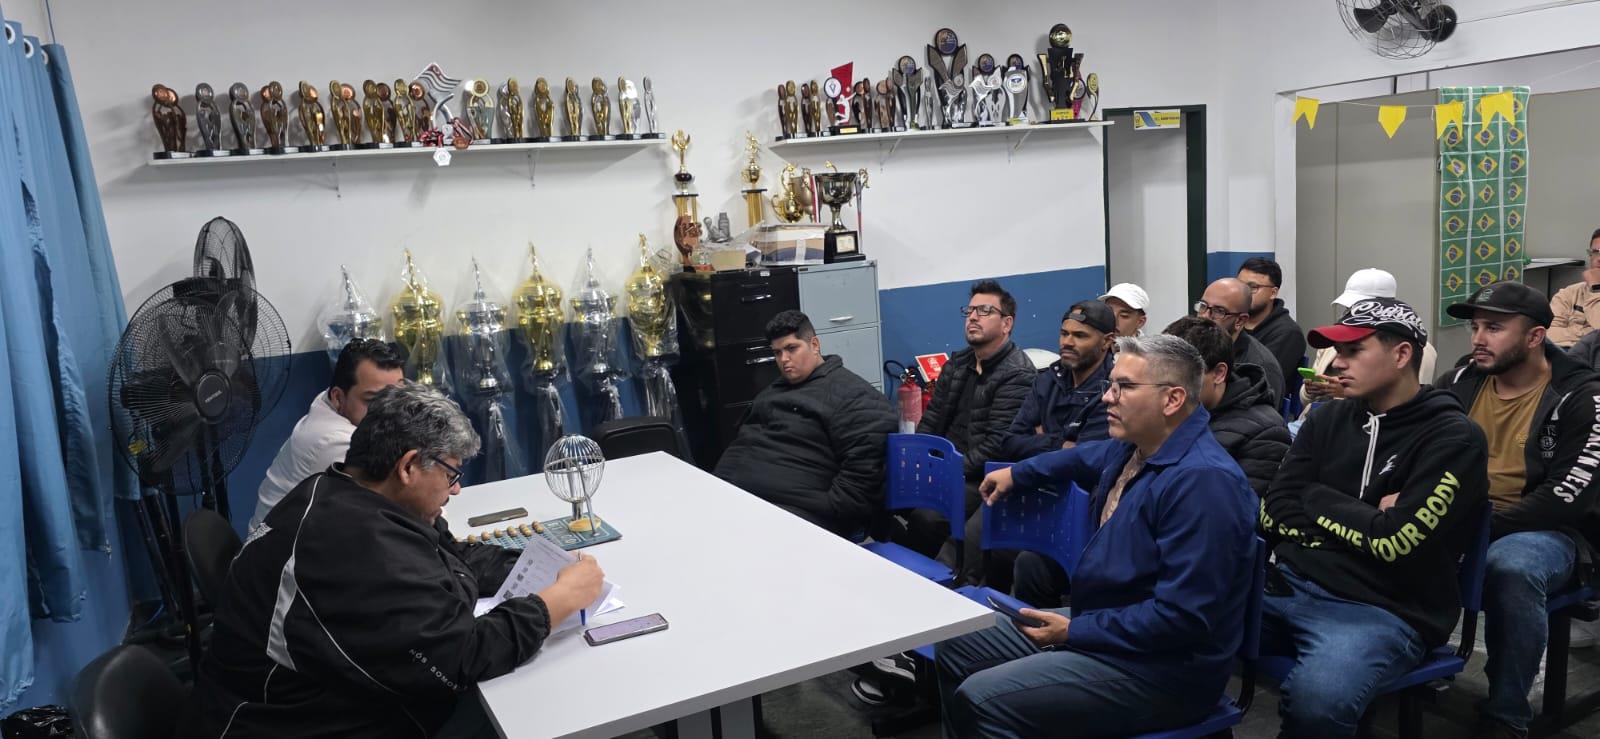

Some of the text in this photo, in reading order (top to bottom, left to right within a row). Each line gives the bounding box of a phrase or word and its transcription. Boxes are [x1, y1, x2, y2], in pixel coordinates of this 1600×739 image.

[1553, 466, 1593, 503] NETS
[1367, 522, 1427, 563] YOUR
[1414, 471, 1461, 530] BODY
